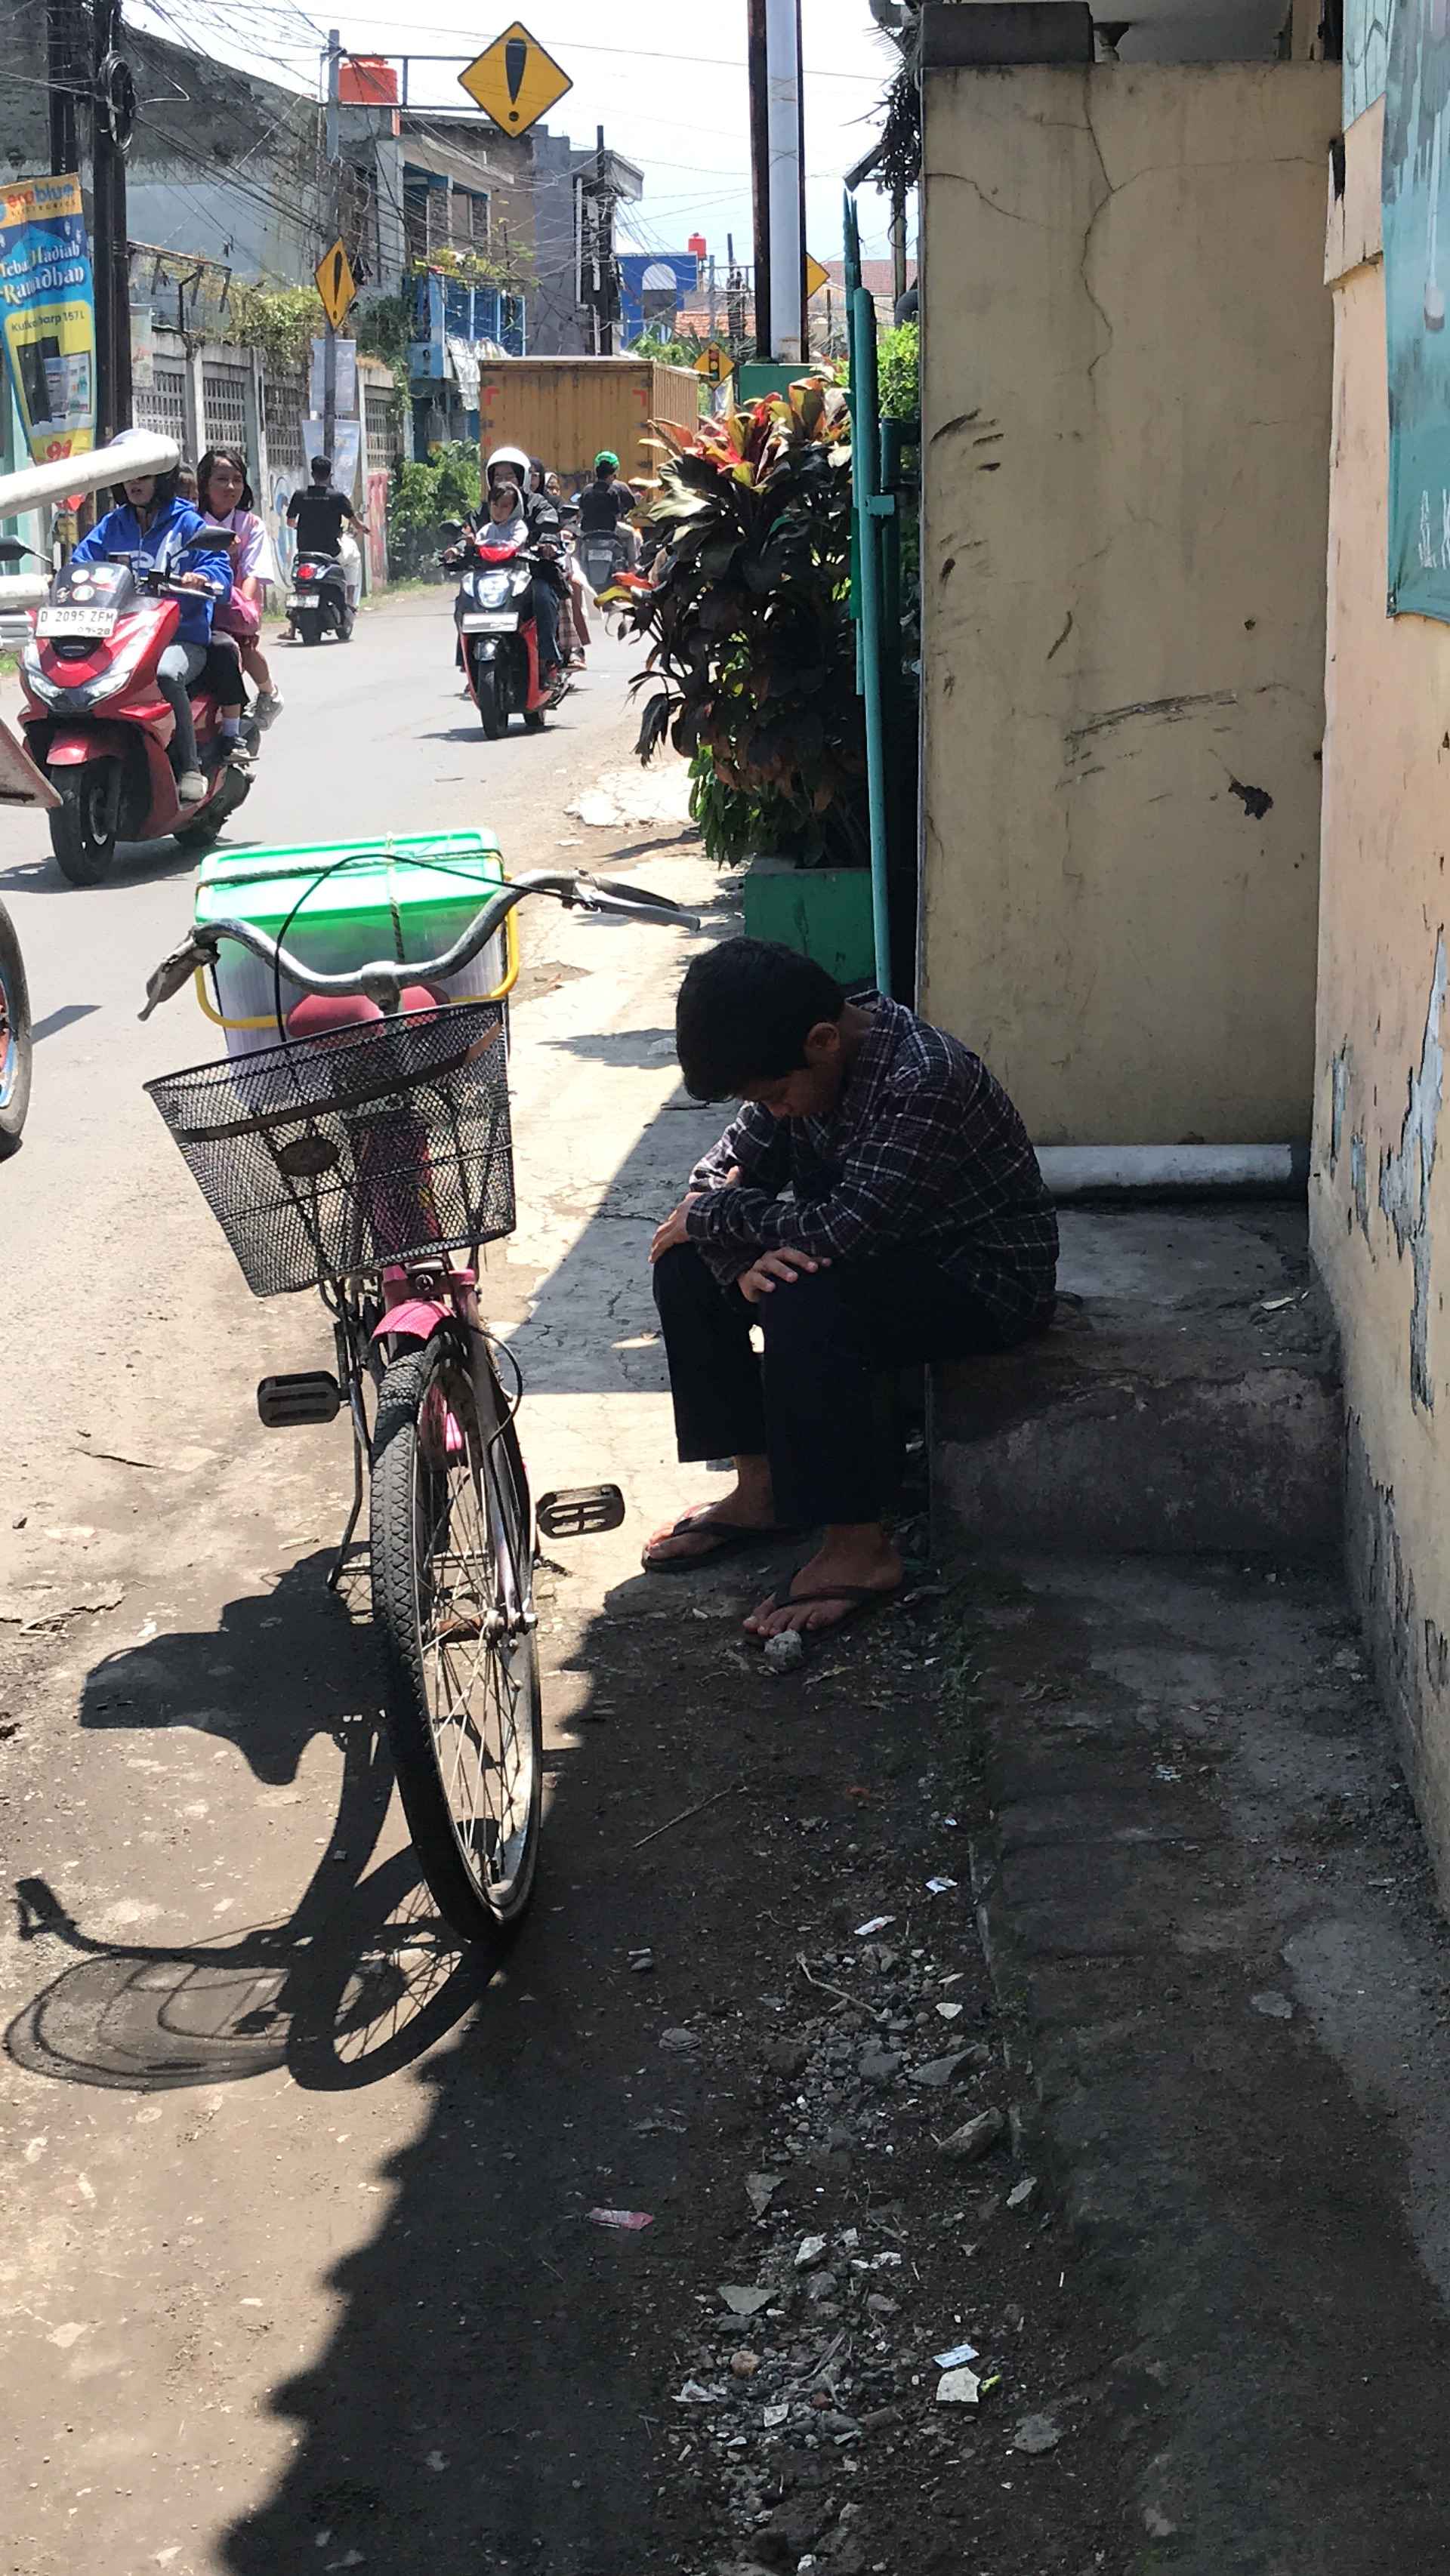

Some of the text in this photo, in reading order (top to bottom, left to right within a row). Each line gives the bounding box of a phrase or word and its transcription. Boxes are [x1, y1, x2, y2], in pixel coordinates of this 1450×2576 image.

[31, 240, 80, 265] Hadiah
[4, 266, 84, 304] Ramadhan
[41, 611, 48, 622] D
[55, 610, 85, 622] 2095
